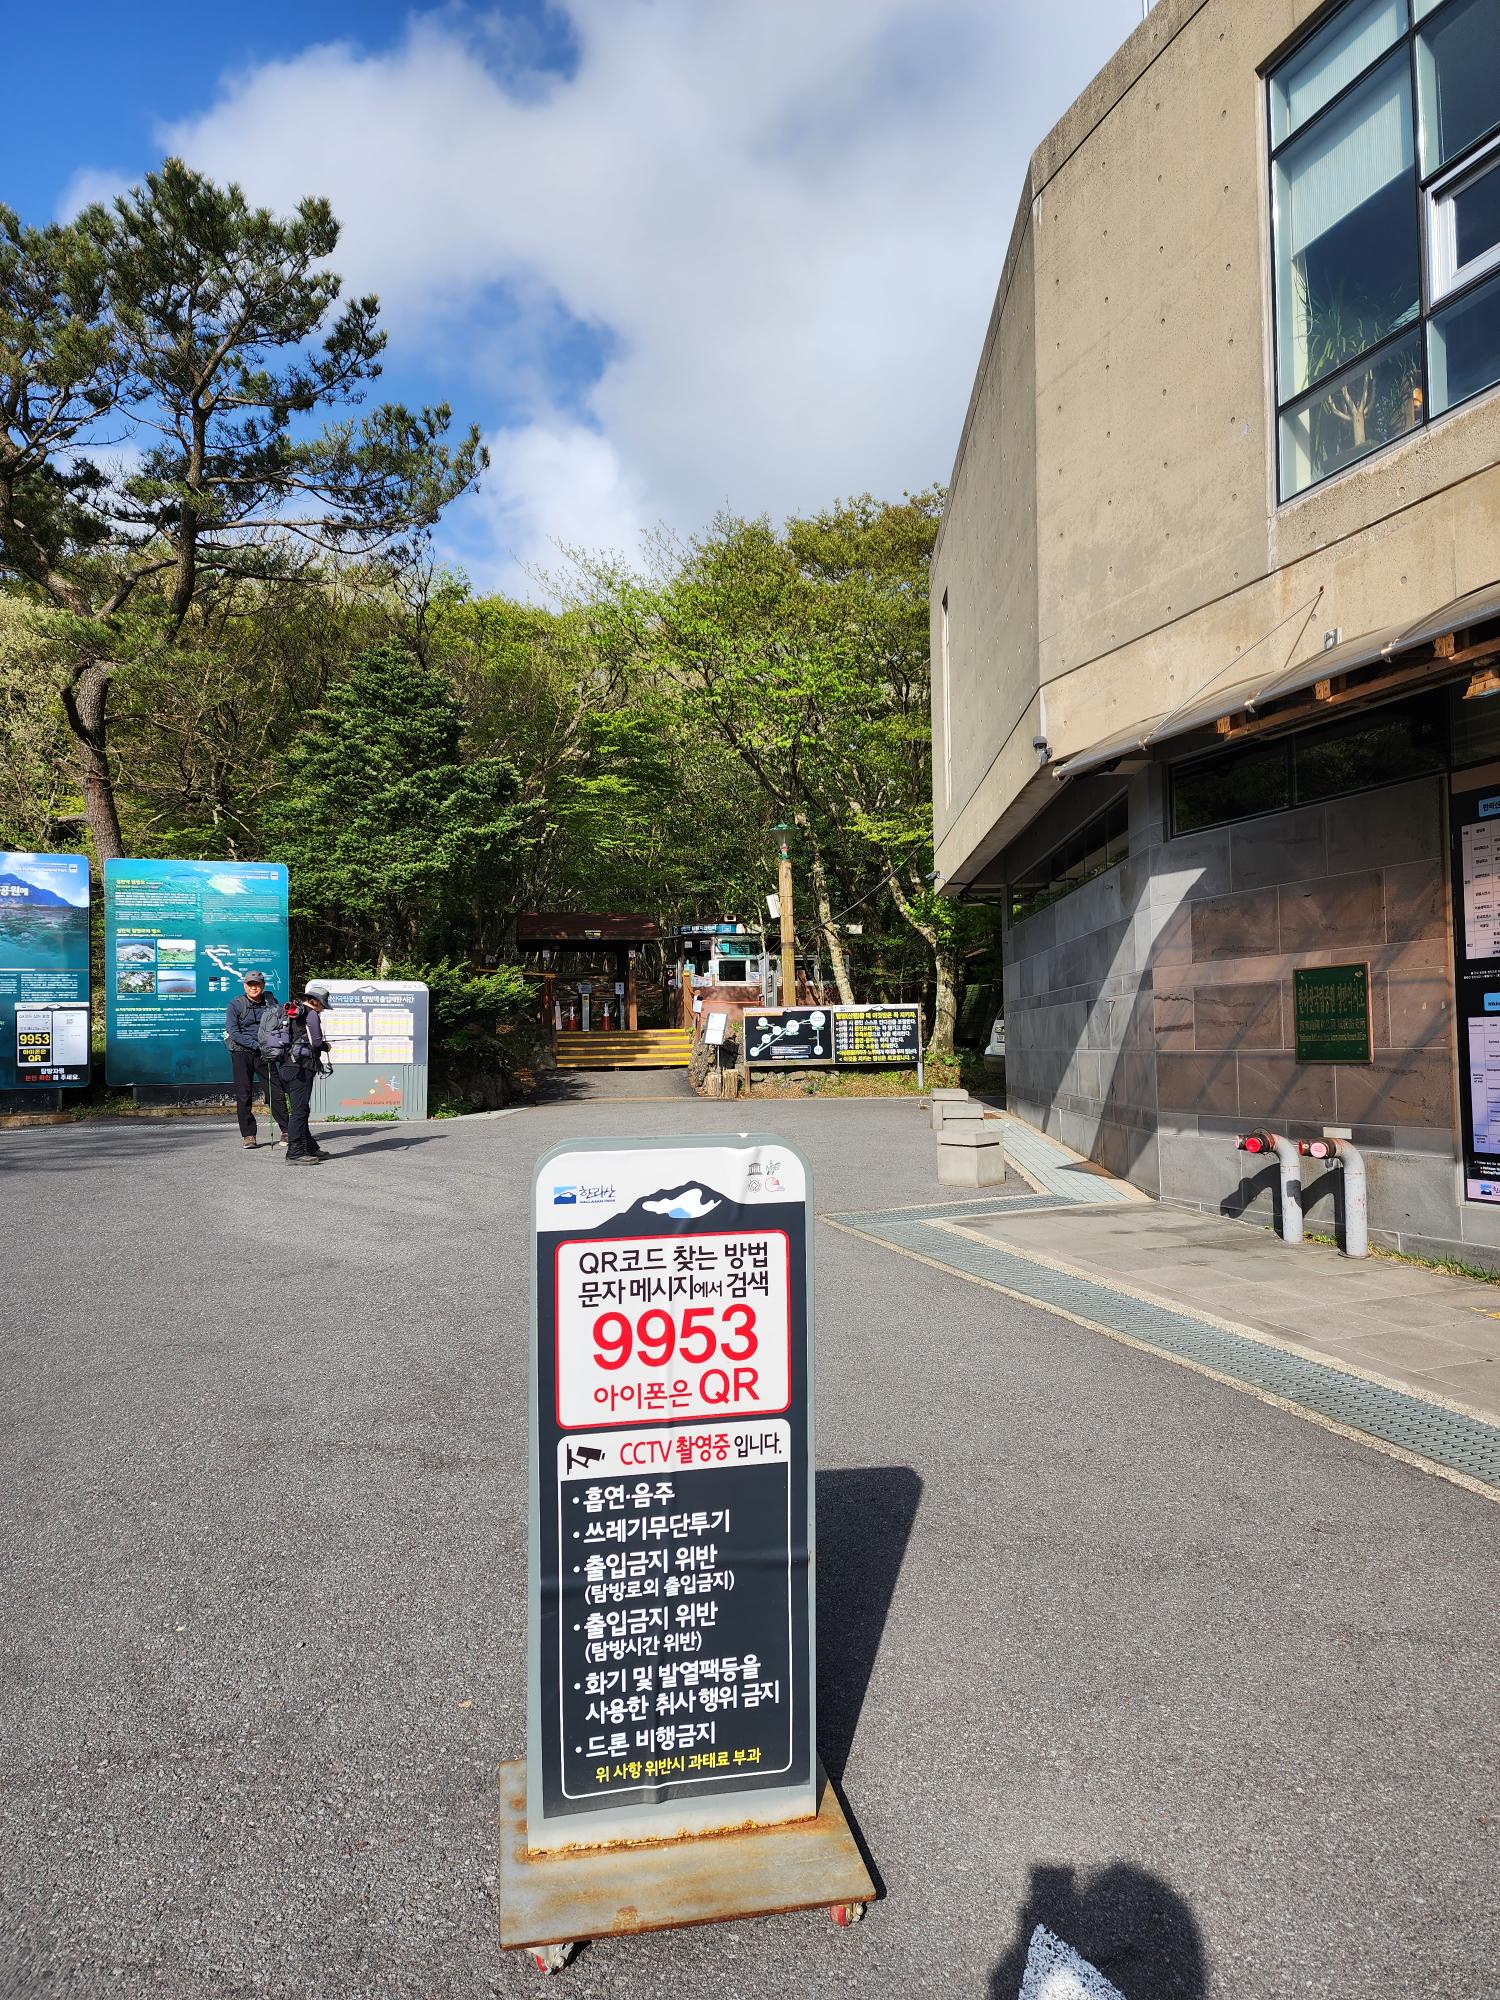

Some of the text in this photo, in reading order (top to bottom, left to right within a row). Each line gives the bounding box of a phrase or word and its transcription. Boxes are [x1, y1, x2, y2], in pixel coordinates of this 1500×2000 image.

[20, 1033, 50, 1045] 9953
[579, 1184, 616, 1199] 한라산
[579, 1241, 769, 1274] QR코드 찾는 방법
[578, 1270, 770, 1308] 문자 메시지에서 검색
[592, 1304, 759, 1370] 9953
[594, 1367, 760, 1411] 아이폰은 QR
[620, 1432, 782, 1465] CCTV 촬영중 입니다.
[583, 1482, 675, 1513] 흡연·음주
[583, 1509, 730, 1544] 쓰레기무단투기
[584, 1544, 718, 1582] 출입금지 위반
[585, 1571, 735, 1604] (탐방로외 출입금지)
[584, 1601, 718, 1640] 출입금지 위반
[585, 1631, 702, 1664] (탐방시간 위반)
[585, 1654, 761, 1695] 화기 및 발열팩등을
[585, 1680, 780, 1724] 사용한 취사 행위 금지
[586, 1721, 716, 1757] 드론 비행금지
[596, 1748, 761, 1783] 위 사항 위반시 과태료 부과
